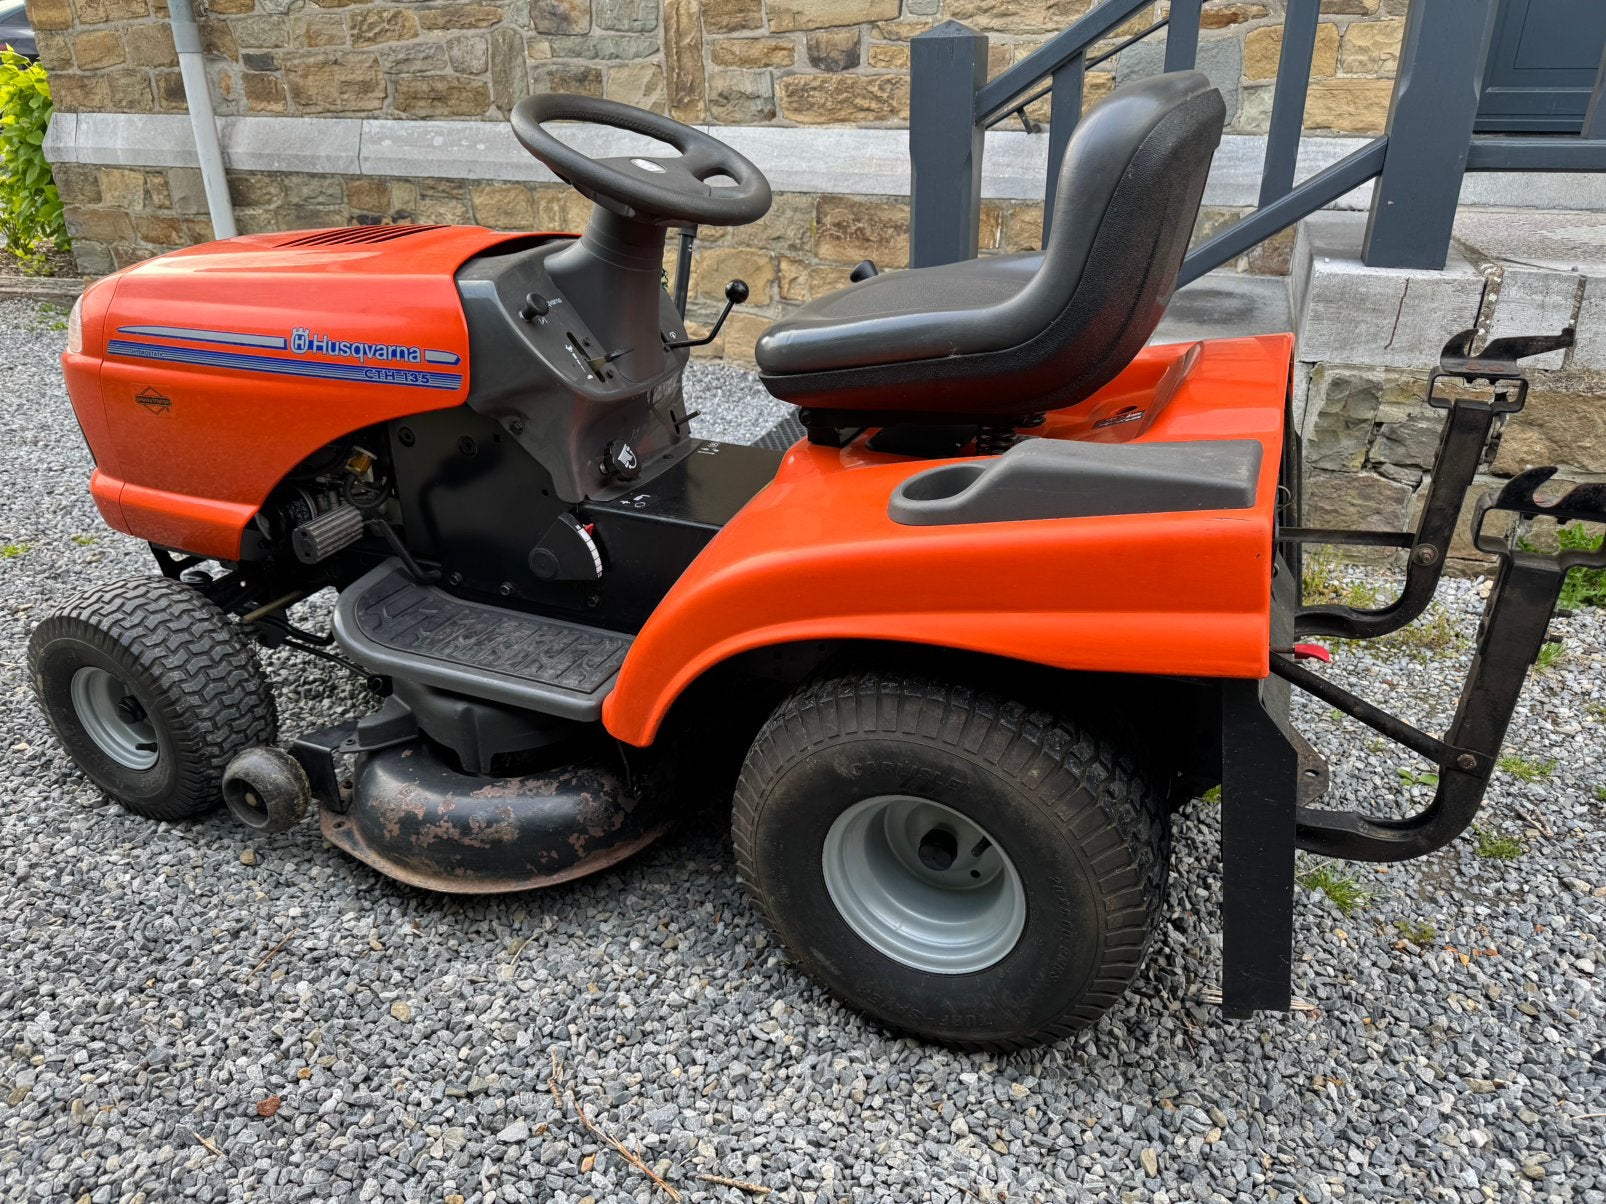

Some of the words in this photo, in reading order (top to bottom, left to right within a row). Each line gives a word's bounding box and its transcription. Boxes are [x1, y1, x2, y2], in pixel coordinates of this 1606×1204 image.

[313, 333, 422, 364] Husqvarna
[364, 369, 396, 381] CTH
[403, 371, 431, 384] 135
